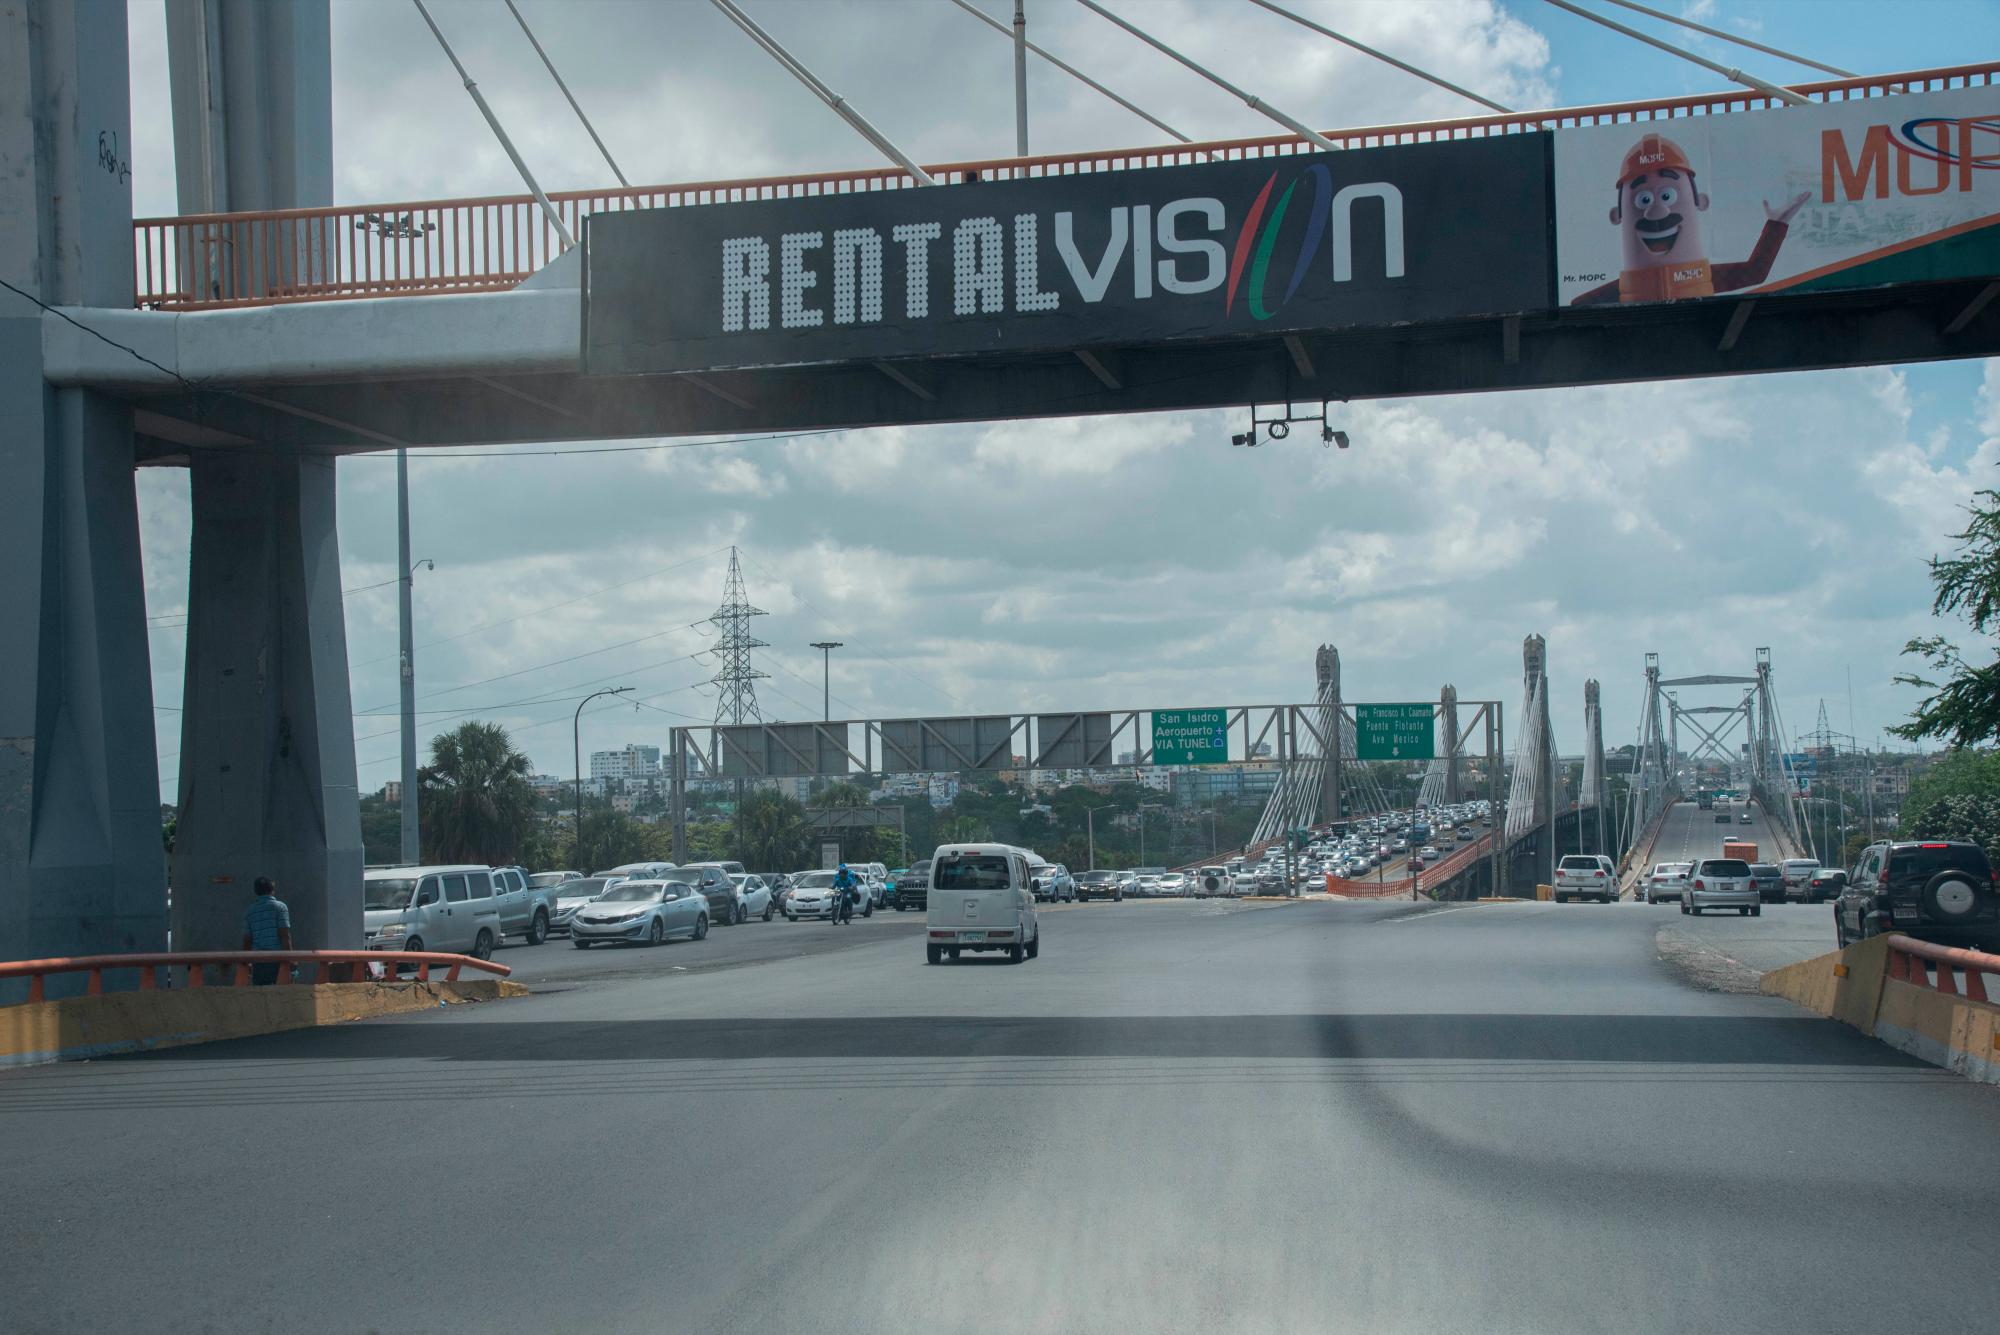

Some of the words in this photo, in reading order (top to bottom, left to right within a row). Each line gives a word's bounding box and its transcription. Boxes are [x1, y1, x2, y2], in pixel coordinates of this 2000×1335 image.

[1563, 275, 1577, 283] Mr.
[1578, 273, 1607, 282] MOPC
[1160, 714, 1181, 724] San
[1187, 712, 1219, 723] Isidro
[1366, 720, 1389, 731] Puente
[1155, 726, 1213, 738] Aeropuerto
[1155, 740, 1174, 750] VIA
[1178, 738, 1212, 749] TUNEL
[1372, 733, 1385, 744] Ave
